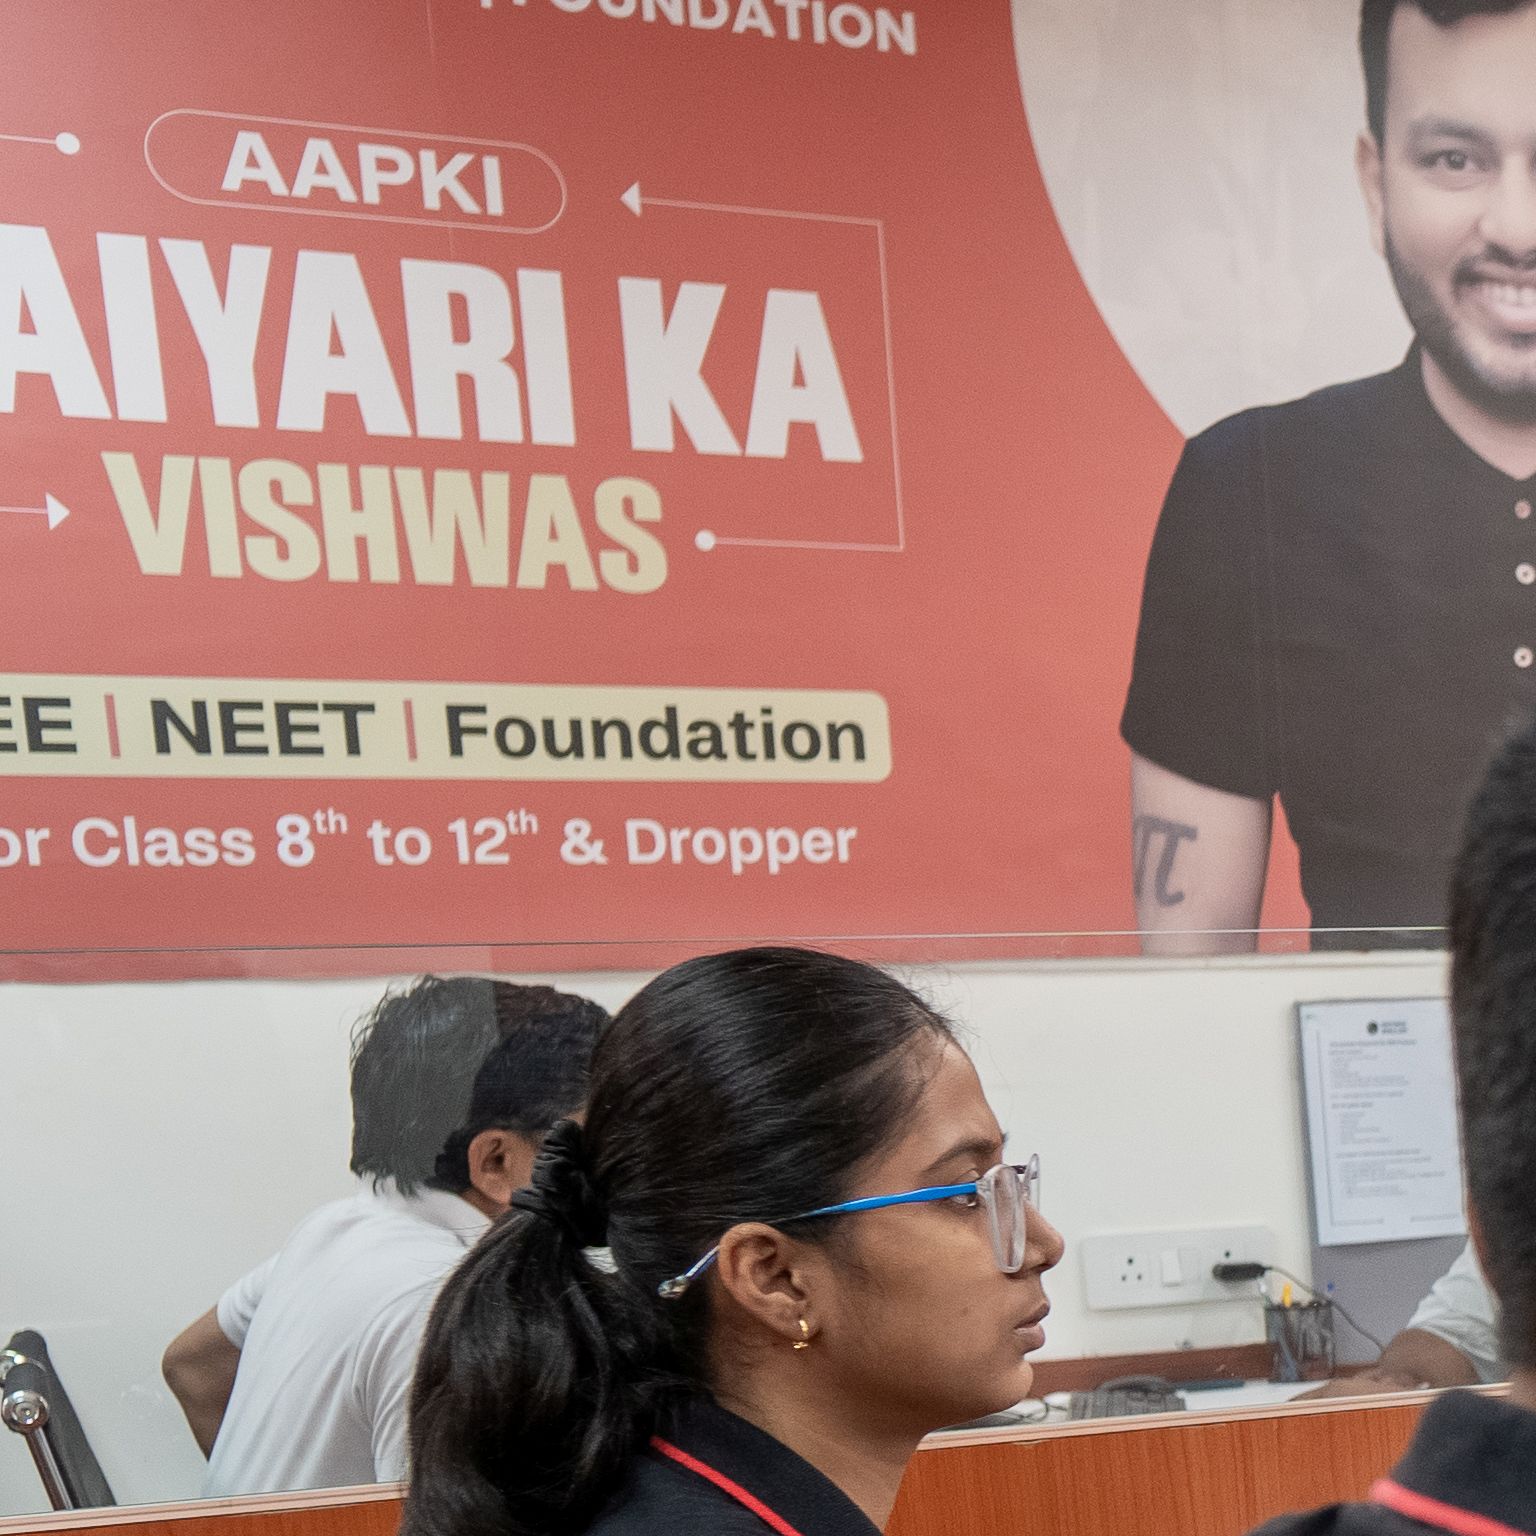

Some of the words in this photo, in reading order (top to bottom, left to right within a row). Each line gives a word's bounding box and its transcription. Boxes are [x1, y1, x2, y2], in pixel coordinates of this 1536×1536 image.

[222, 130, 504, 217] AAPKI
[0, 222, 577, 447] AIYARI
[618, 276, 864, 463] KA
[101, 451, 668, 594] VISHWAS
[150, 699, 376, 758] NEET
[445, 702, 868, 763] Foundation
[0, 819, 49, 867] or
[71, 815, 256, 868] Class
[276, 806, 349, 866] 8th
[367, 818, 432, 866] to
[449, 808, 539, 866] 12th
[560, 822, 606, 866] &
[625, 819, 857, 875] Dropper
